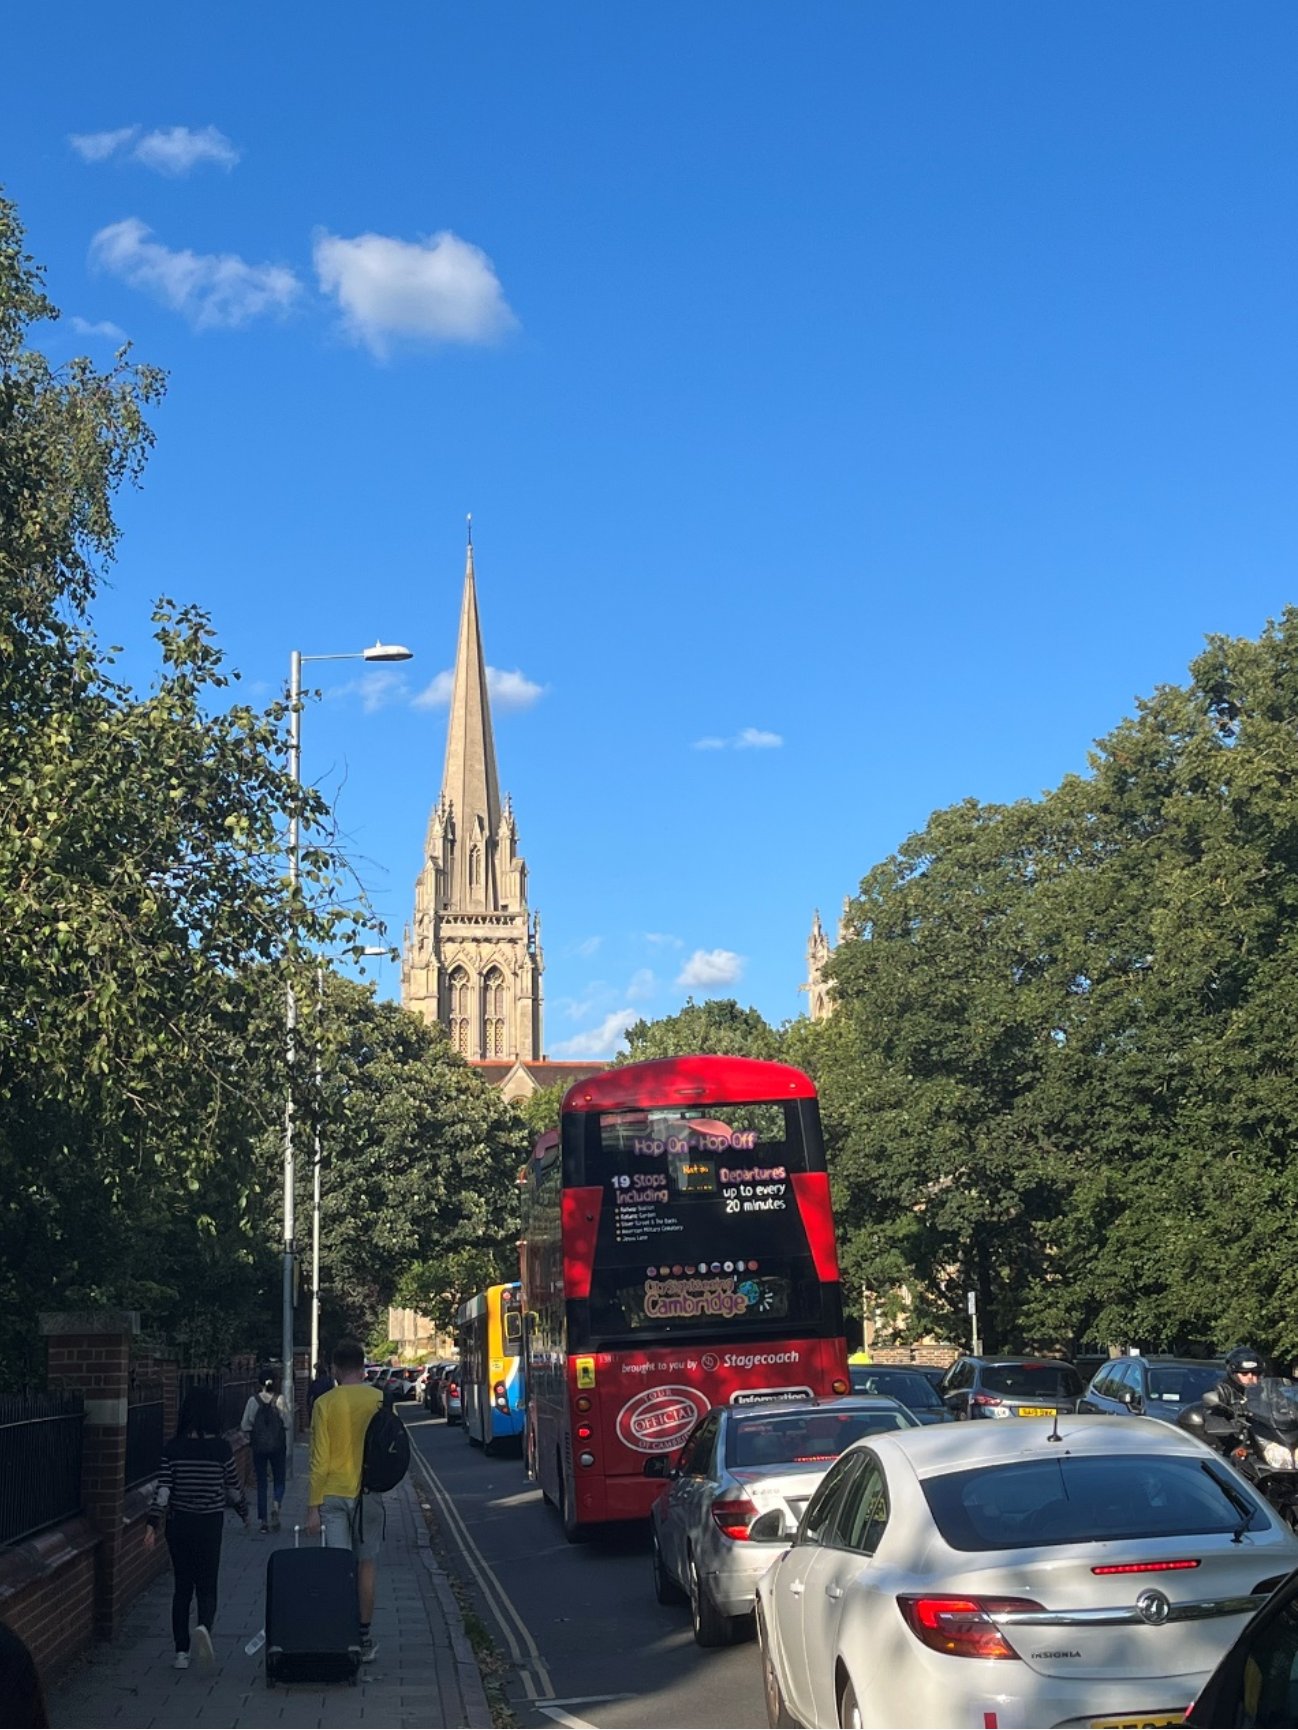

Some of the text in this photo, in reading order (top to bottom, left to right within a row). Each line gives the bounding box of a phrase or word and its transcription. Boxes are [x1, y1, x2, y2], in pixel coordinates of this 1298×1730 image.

[635, 1139, 664, 1154] Hop
[667, 1136, 689, 1153] On
[699, 1135, 729, 1152] Hop
[731, 1132, 756, 1149] Off
[611, 1174, 667, 1188] 19 Stops
[720, 1166, 786, 1182] Departures
[616, 1189, 669, 1204] Including
[723, 1187, 737, 1199] up
[740, 1185, 753, 1196] to
[756, 1184, 786, 1196] every
[726, 1198, 786, 1213] 20 minutes
[645, 1291, 748, 1318] Cambridge
[622, 1351, 799, 1375] brought to you by Stagecoach
[643, 1389, 672, 1402] TOUR
[635, 1407, 692, 1431] OFFICIAL
[639, 1441, 649, 1449] OF
[1031, 1650, 1082, 1659] INSIGNIA
